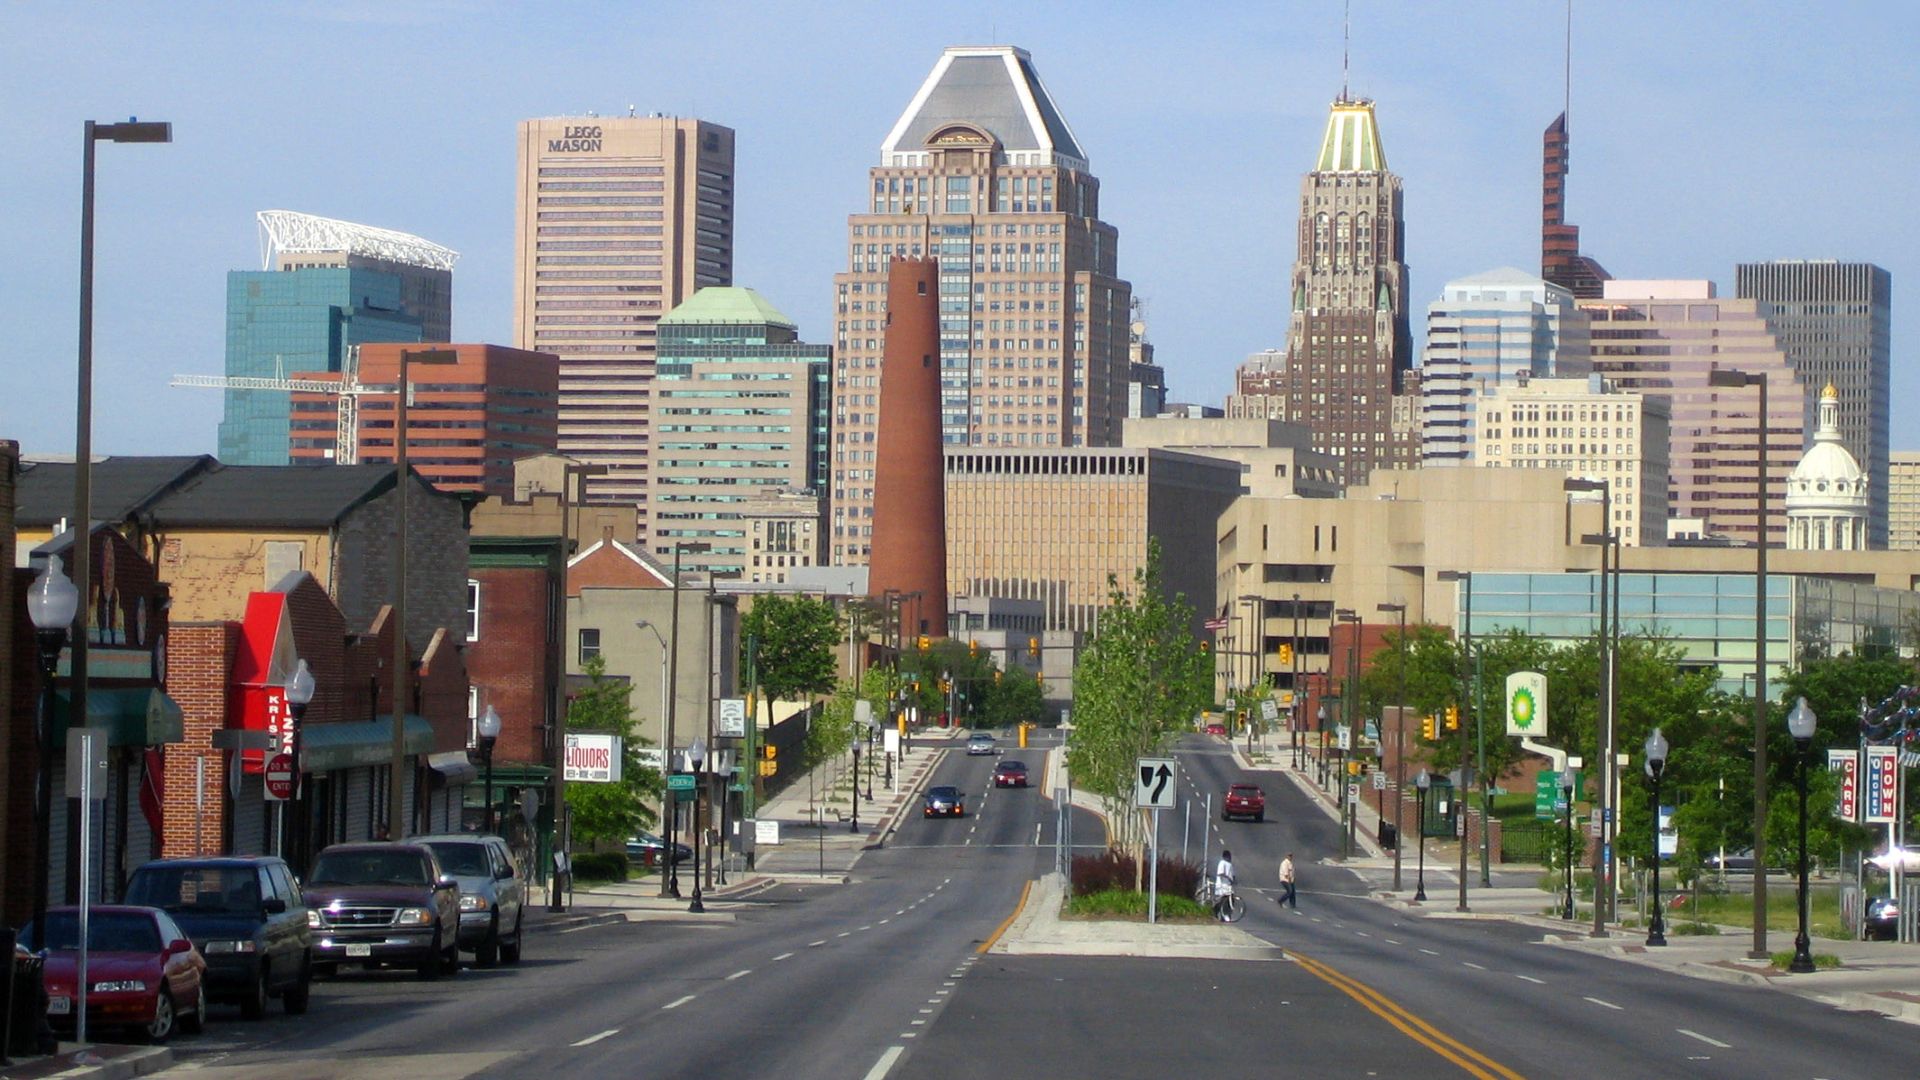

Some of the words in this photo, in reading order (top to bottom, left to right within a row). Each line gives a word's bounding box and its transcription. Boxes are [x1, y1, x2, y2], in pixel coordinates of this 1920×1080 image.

[564, 126, 602, 139] LEGG
[548, 139, 602, 152] MASON
[269, 696, 279, 733] KRIS
[566, 747, 609, 769] LIQUORS
[273, 783, 292, 791] ENTE
[1843, 761, 1853, 815] CARS
[1882, 760, 1894, 813] DOWN
